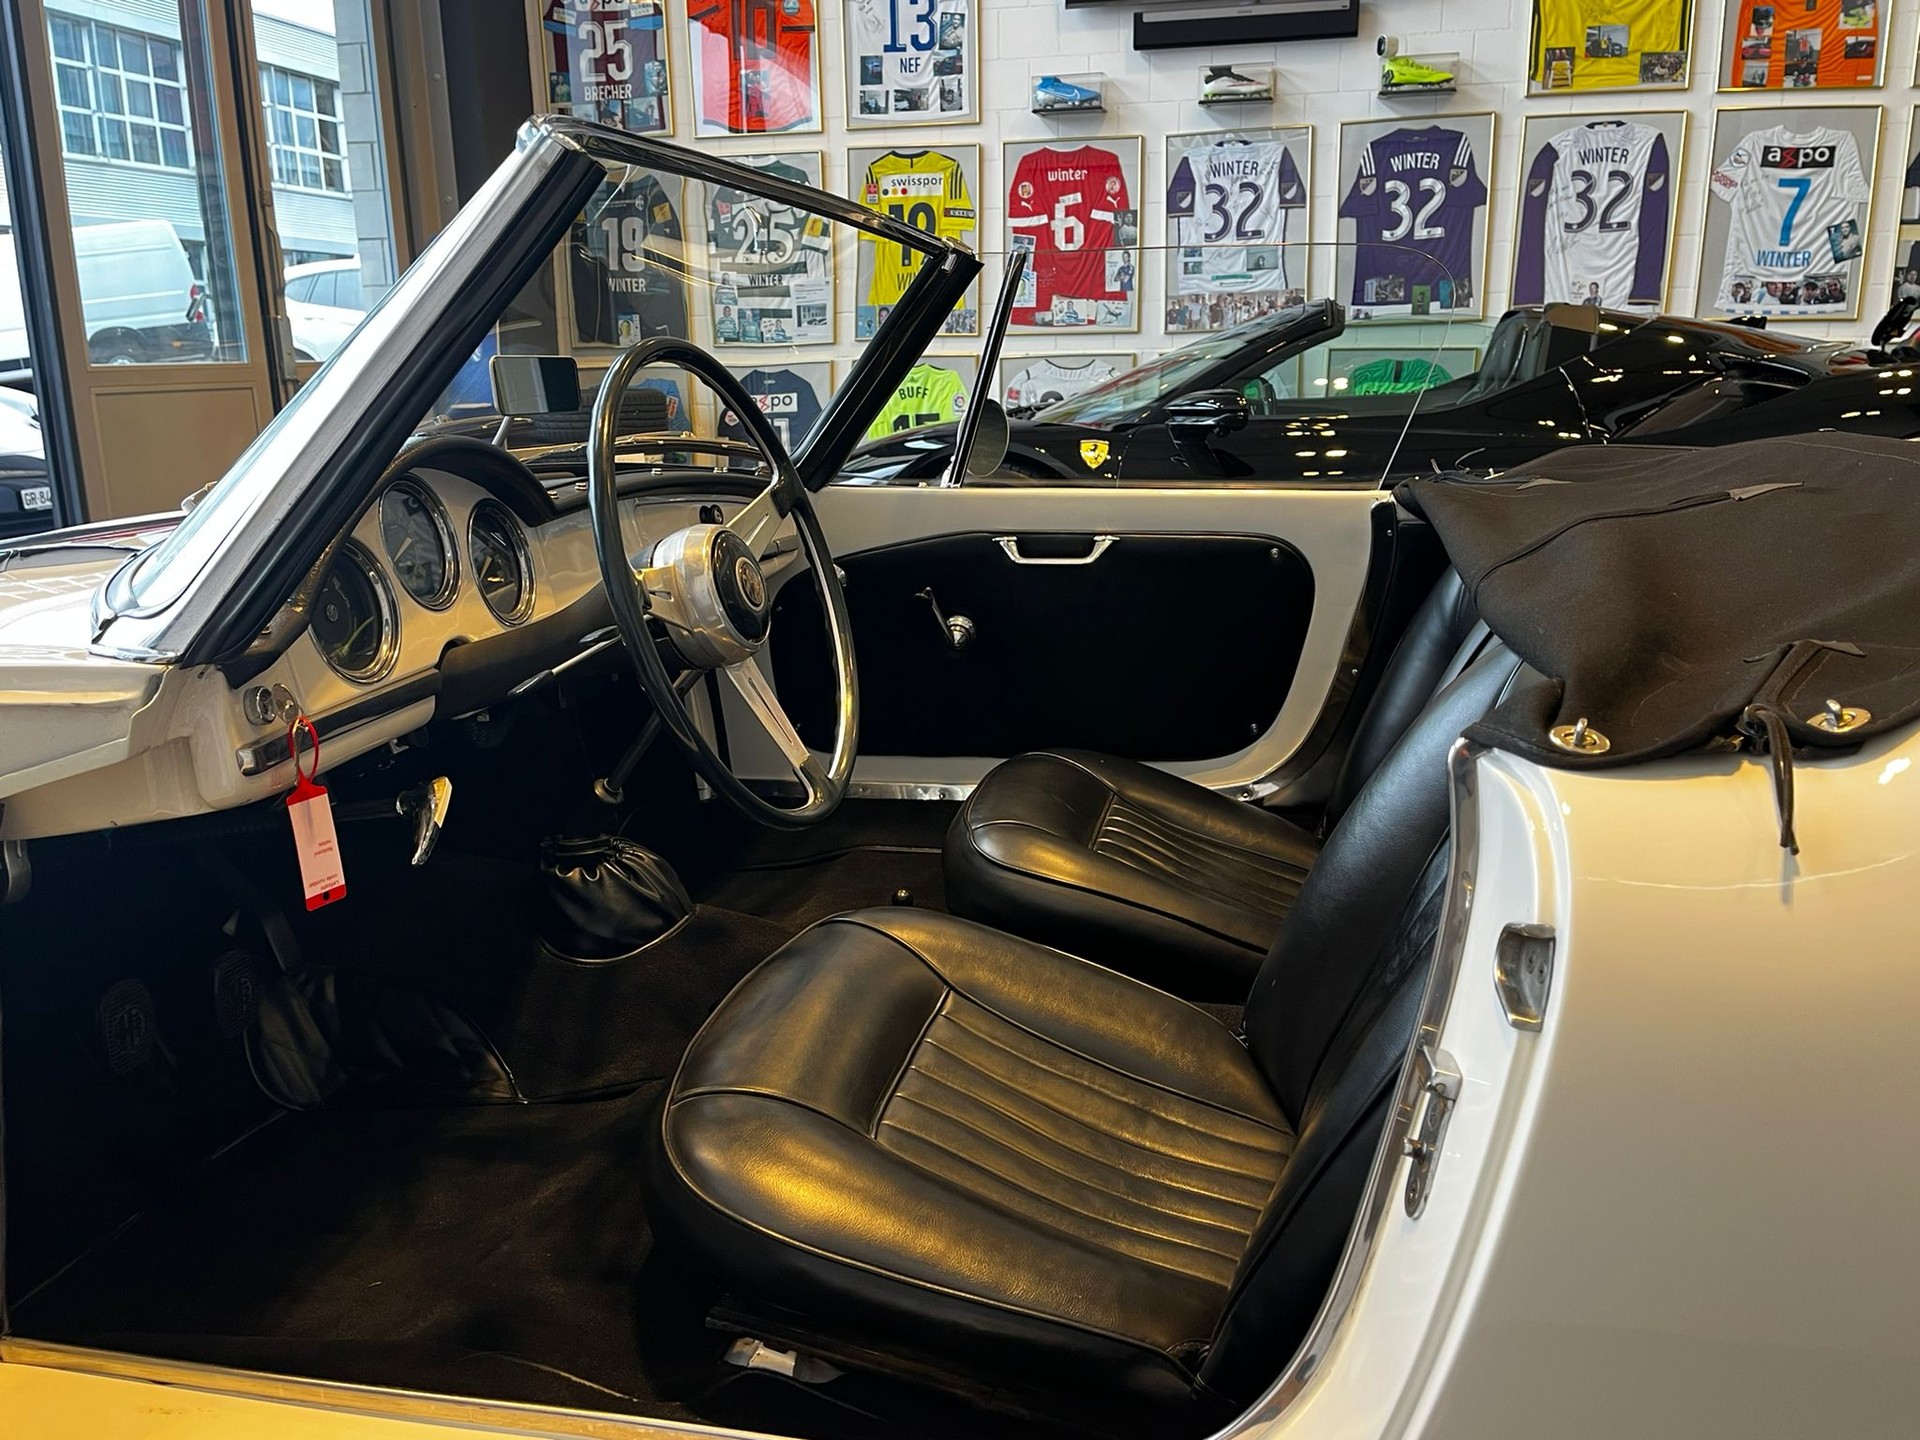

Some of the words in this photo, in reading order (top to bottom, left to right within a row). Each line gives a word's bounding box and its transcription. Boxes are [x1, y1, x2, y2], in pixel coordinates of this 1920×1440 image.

[883, 0, 937, 52] 13
[578, 18, 633, 82] 25
[900, 57, 921, 73] NEF
[584, 84, 632, 101] BRECHER
[1390, 152, 1440, 172] WINTER
[1579, 147, 1629, 165] WINTER
[1048, 168, 1088, 181] winter
[1210, 160, 1259, 178] WINTER
[1382, 178, 1445, 241] 32
[1564, 170, 1634, 233] 32
[1051, 192, 1084, 251] 6
[1204, 182, 1264, 242] 32
[1778, 178, 1812, 246] 7
[602, 217, 645, 272] 19
[732, 206, 795, 264] 25
[1757, 250, 1812, 267] WINTER
[608, 278, 646, 292] WINTER
[749, 274, 783, 286] WINTER
[898, 386, 929, 400] BUFF
